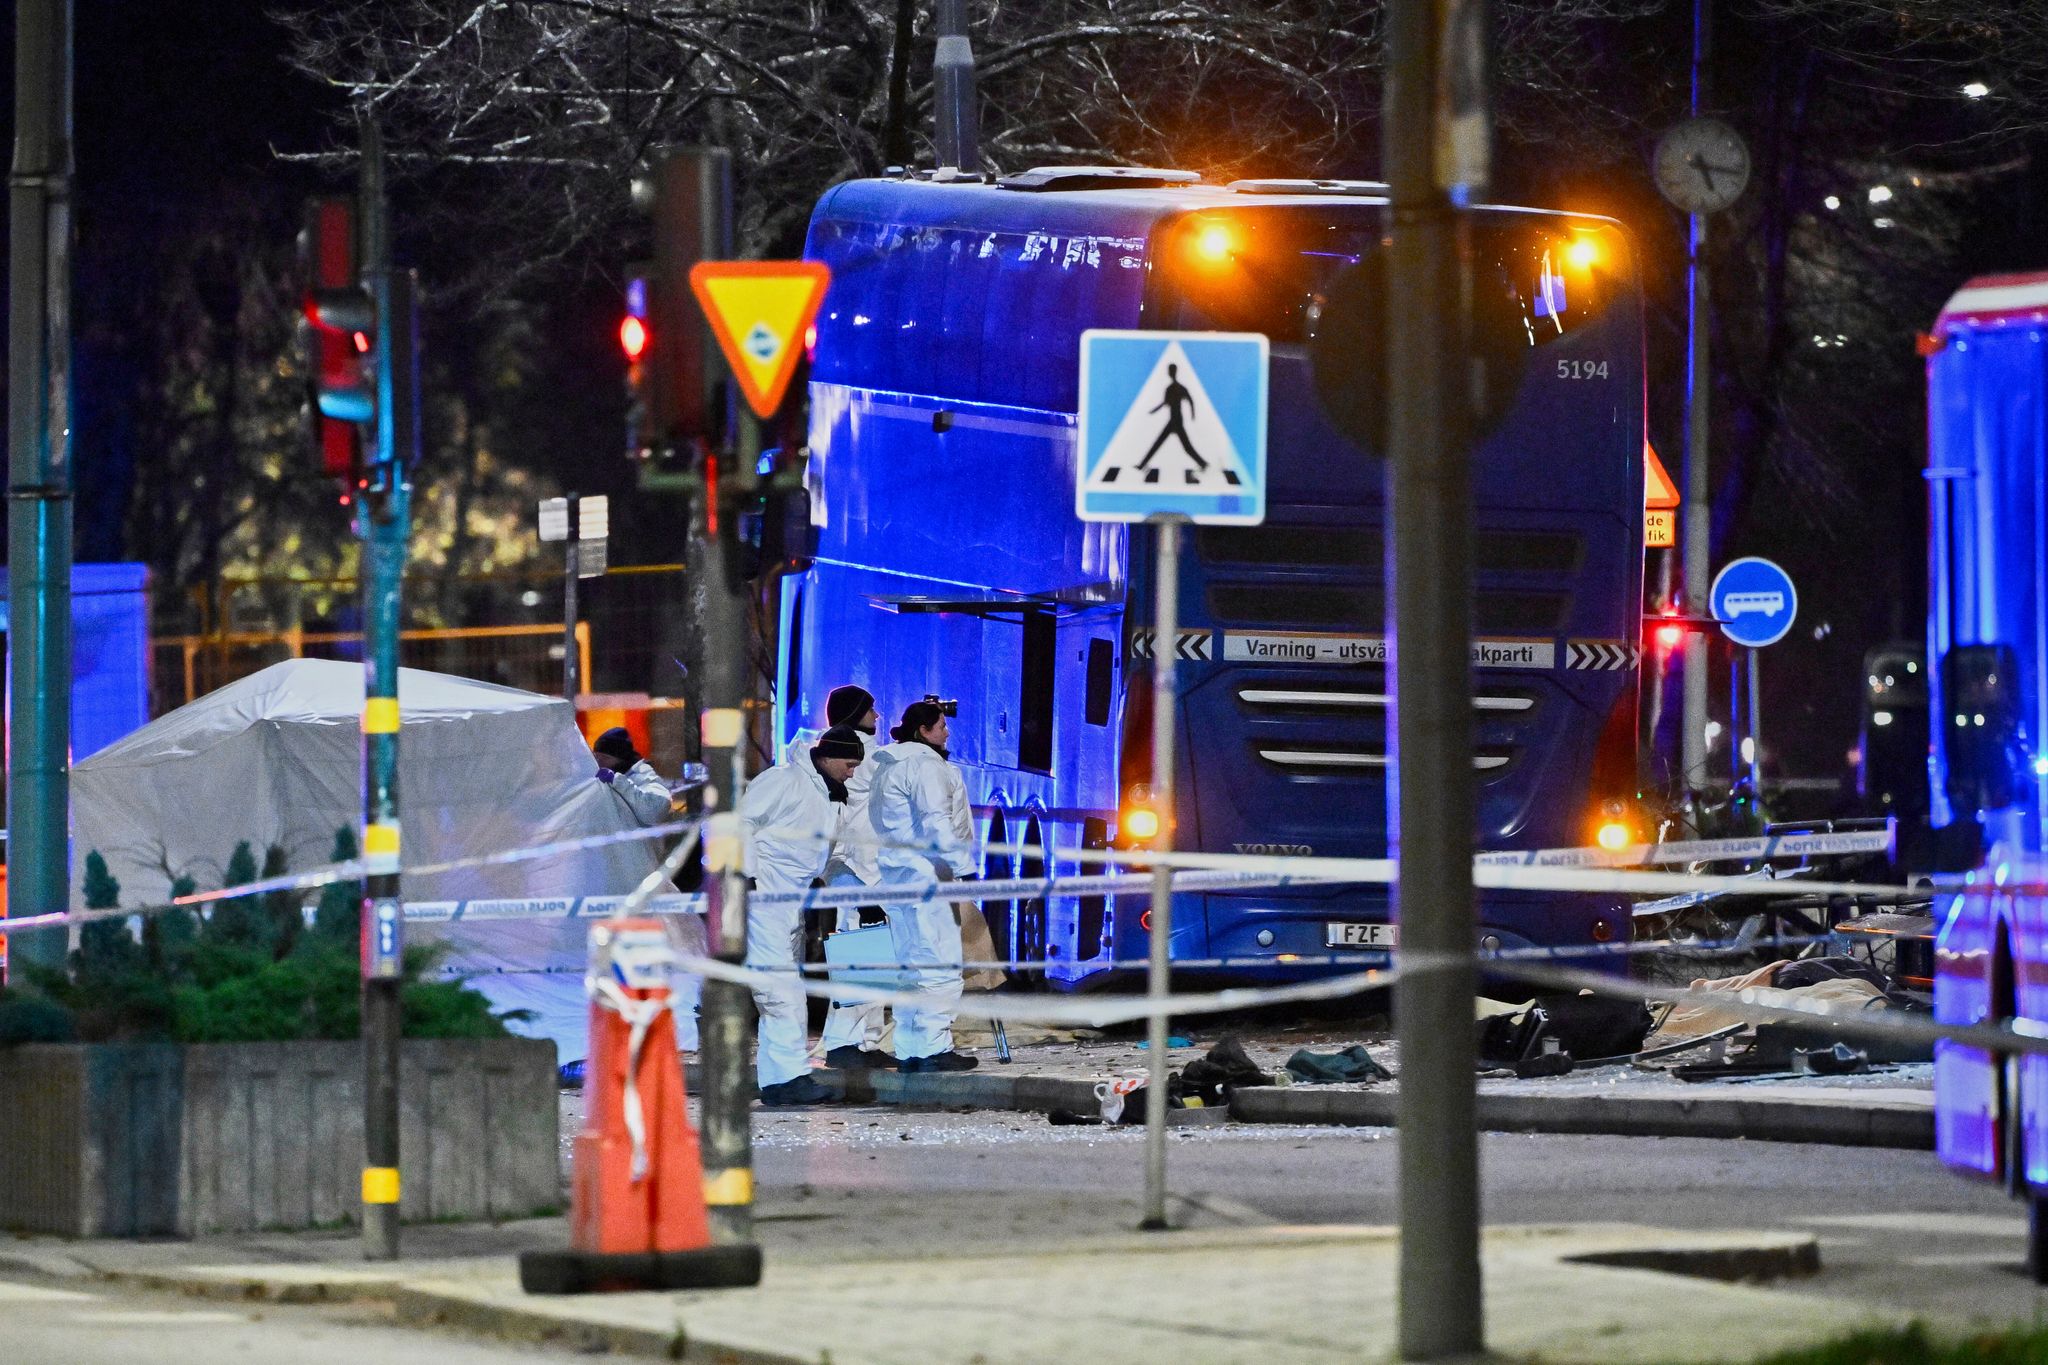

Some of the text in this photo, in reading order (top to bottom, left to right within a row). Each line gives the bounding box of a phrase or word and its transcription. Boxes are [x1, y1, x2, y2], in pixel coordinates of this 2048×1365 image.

[1557, 359, 1609, 380] 5194
[1646, 515, 1664, 526] de
[1246, 639, 1316, 660] Varning
[1233, 843, 1313, 856] VOLVO
[1344, 925, 1381, 944] FZF
